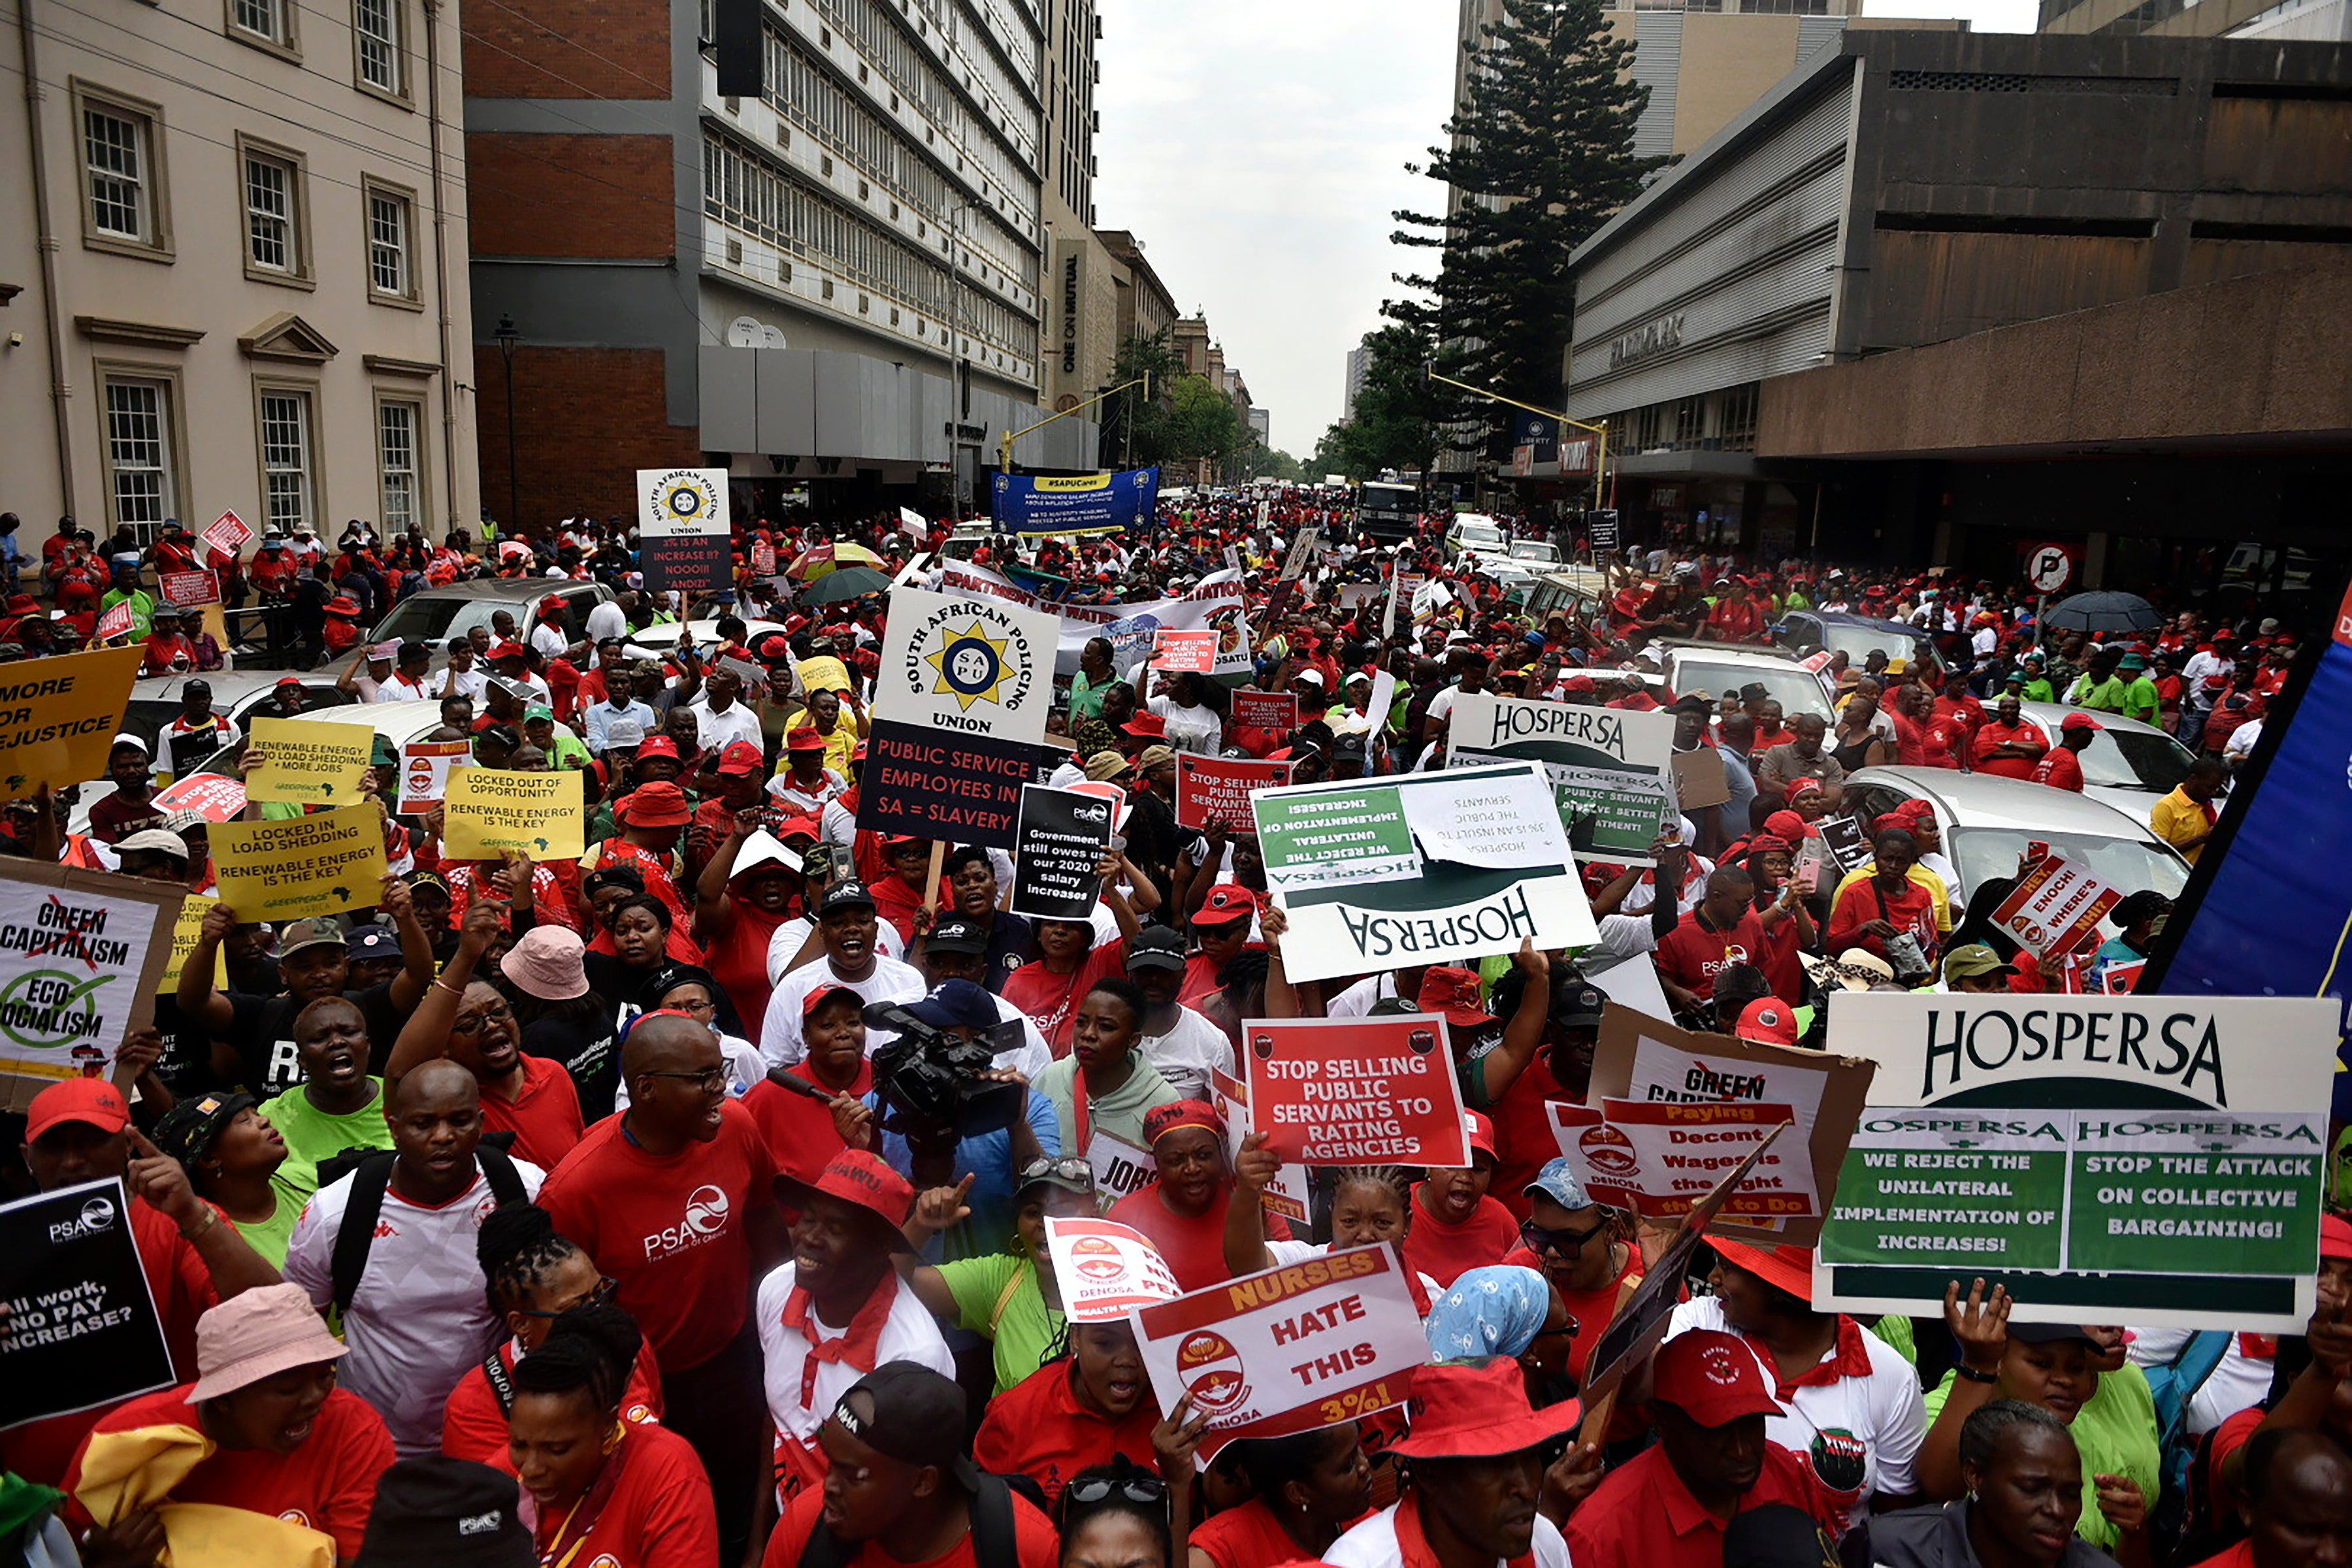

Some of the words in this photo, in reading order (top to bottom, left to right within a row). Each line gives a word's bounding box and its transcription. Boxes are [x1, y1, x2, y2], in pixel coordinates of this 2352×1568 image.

[1066, 254, 1077, 314] MUTUAL
[1064, 316, 1076, 339] ON
[1063, 342, 1075, 373] ONE
[1521, 436, 1550, 445] LIBERTY
[657, 470, 701, 488] AFRICAN
[651, 489, 664, 521] SOUTH
[701, 478, 718, 521] POLICING
[681, 538, 689, 547] IS
[693, 538, 708, 546] AN
[653, 551, 704, 561] INCREASE
[2039, 555, 2059, 581] P
[1040, 602, 1062, 615] OF
[1110, 632, 1154, 645] WFTU
[906, 628, 928, 694] SOUTH
[927, 601, 1011, 630] AFRICAN
[1005, 627, 1032, 711] POLICING
[0, 676, 75, 702] MORE
[933, 713, 992, 734] UNION
[1491, 704, 1625, 761] HOSPERSA
[254, 742, 319, 752] RENEWABLE
[320, 744, 364, 755] ENERGY
[278, 752, 306, 760] LOAD
[308, 753, 367, 766] SHEDDING
[282, 762, 312, 771] MORE
[314, 764, 342, 773] JOBS
[877, 739, 946, 765] PUBLIC
[950, 751, 1032, 778] SERVICE
[467, 774, 515, 787] LOCKED
[517, 779, 543, 787] OUT
[546, 779, 563, 787] OF
[881, 767, 992, 800] EMPLOYEES
[997, 785, 1018, 803] IN
[1189, 772, 1220, 786] STOP
[1223, 777, 1279, 789] SELLING
[1560, 770, 1665, 791] HOSPERSA
[177, 785, 205, 805] STOP
[470, 785, 555, 798] OPPORTUNITY
[1564, 787, 1605, 800] PUBLIC
[1609, 792, 1659, 805] SERVANT
[1288, 799, 1367, 815] INCREASES!
[1454, 795, 1511, 808] SERVANTS
[451, 804, 523, 818] RENEWABLE
[527, 808, 575, 818] ENERGY
[877, 796, 904, 815] SA
[928, 804, 1011, 831] SLAVERY
[1455, 813, 1497, 824] PUBLIC
[1499, 811, 1518, 820] THE
[1616, 808, 1657, 819] BETTER
[253, 824, 314, 841] LOCKED
[319, 819, 335, 831] IN
[484, 817, 495, 825] IS
[498, 817, 520, 828] THE
[523, 819, 546, 828] KEY
[1264, 825, 1281, 833] OF
[1284, 812, 1398, 830] IMPLEMENTATION
[1497, 825, 1514, 835] AN
[232, 841, 274, 854] LOAD
[278, 826, 359, 850] SHEDDING
[1030, 829, 1100, 845] Government
[1292, 831, 1376, 847] UNILATERAL
[1437, 829, 1454, 839] TO
[1456, 826, 1494, 839] INSULT
[1023, 843, 1048, 854] still
[1051, 847, 1086, 858] owes
[1090, 851, 1106, 860] us
[1317, 847, 1365, 860] REJECT
[1369, 845, 1390, 855] WE
[1465, 841, 1525, 853] HOSPERSA
[221, 858, 314, 878] RENEWABLE
[319, 845, 376, 866] ENERGY
[1034, 859, 1055, 868] our
[1058, 860, 1090, 872] 2020
[1286, 853, 1313, 864] THE
[263, 877, 278, 887] IS
[281, 871, 312, 883] THE
[316, 865, 344, 879] KEY
[1041, 873, 1081, 888] salary
[1269, 859, 1416, 885] HOSPERSA
[2022, 868, 2052, 893] HEY,
[1027, 884, 1088, 901] increases
[2033, 870, 2076, 913] ENOCH!
[188, 902, 203, 912] OUT
[2048, 879, 2097, 928] WHERE'S
[37, 902, 108, 935] GREEN
[1336, 885, 1539, 958] HOSPERSA
[2074, 900, 2107, 931] NHI?
[1, 924, 129, 966] CAPITALISM
[1702, 961, 1728, 974] PSA
[26, 978, 76, 1005] ECO-
[1266, 1059, 1319, 1079] STOP
[1325, 1055, 1428, 1079] SELLING
[1921, 1010, 2228, 1109] HOSPERSA
[1303, 1079, 1390, 1102] PUBLIC
[1685, 1069, 1766, 1101] GREEN
[1273, 1100, 1394, 1124] SERVANTS
[1397, 1098, 1433, 1116] TO
[1666, 1105, 1756, 1122] Paying
[1308, 1120, 1402, 1143] RATING
[1669, 1129, 1764, 1144] Decent
[2077, 1122, 2321, 1145] HOSPERSA
[1301, 1136, 1421, 1160] AGENCIES
[1662, 1154, 1743, 1171] Wages
[1864, 1153, 1898, 1168] WE
[1904, 1154, 1984, 1169] REJECT
[1989, 1155, 2031, 1170] THE
[2085, 1157, 2152, 1173] STOP
[2159, 1158, 2208, 1174] THE
[2215, 1158, 2313, 1177] ATTACK
[1591, 1176, 1644, 1192] DENOSA
[1671, 1178, 1714, 1191] the
[1878, 1180, 2013, 1196] UNILATERAL
[1733, 1199, 1765, 1210] to
[1768, 1198, 1803, 1210] Do
[2097, 1188, 2133, 1204] ON
[2141, 1188, 2298, 1207] COLLECTIVE
[1833, 1207, 2019, 1225] IMPLEMENTATION
[2026, 1209, 2056, 1226] OF
[49, 1218, 88, 1242] PSA
[2108, 1219, 2284, 1239] BARGAINING!
[644, 1221, 697, 1258] PSA
[647, 1253, 664, 1264] The
[666, 1243, 690, 1258] Union
[702, 1229, 728, 1243] Choice
[1878, 1235, 2007, 1252] INCREASES!
[1228, 1252, 1375, 1311] NURSES
[37, 1281, 107, 1307] work,
[1080, 1287, 1134, 1298] DENOSA
[8, 1312, 46, 1332] NO
[53, 1296, 103, 1322] PAY
[1075, 1305, 1117, 1316] HEALTH
[1269, 1294, 1367, 1347] HATE
[1290, 1342, 1377, 1386] THIS
[1320, 1382, 1392, 1422] 3%!
[459, 1516, 485, 1534] PSA
